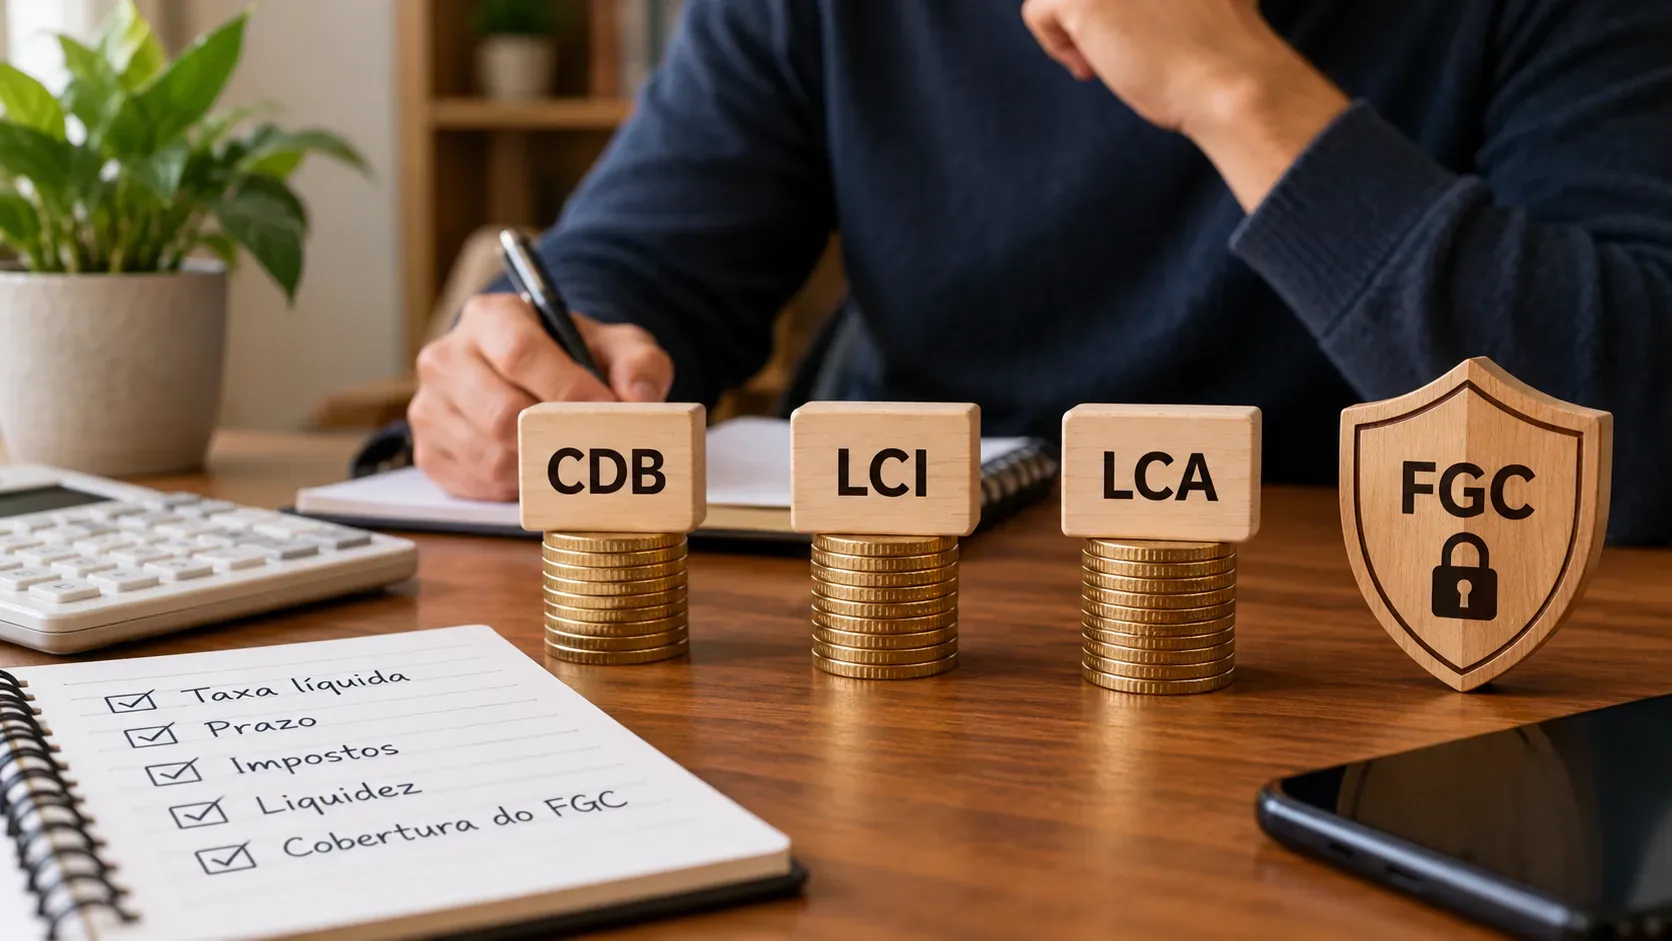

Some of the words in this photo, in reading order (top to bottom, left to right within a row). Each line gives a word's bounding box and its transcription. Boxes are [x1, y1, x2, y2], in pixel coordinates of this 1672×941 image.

[547, 447, 666, 495] CDB
[837, 447, 927, 498] LCI
[1103, 450, 1219, 502] LCA
[1401, 460, 1536, 521] FGC
[180, 686, 279, 703] Taxa
[290, 669, 411, 696] líquida
[203, 717, 317, 738] Prazo
[230, 744, 399, 775] Impostos
[255, 782, 423, 816] Liquidez
[283, 818, 479, 857] Cobertura
[493, 805, 534, 826] do
[543, 790, 628, 817] FGC
